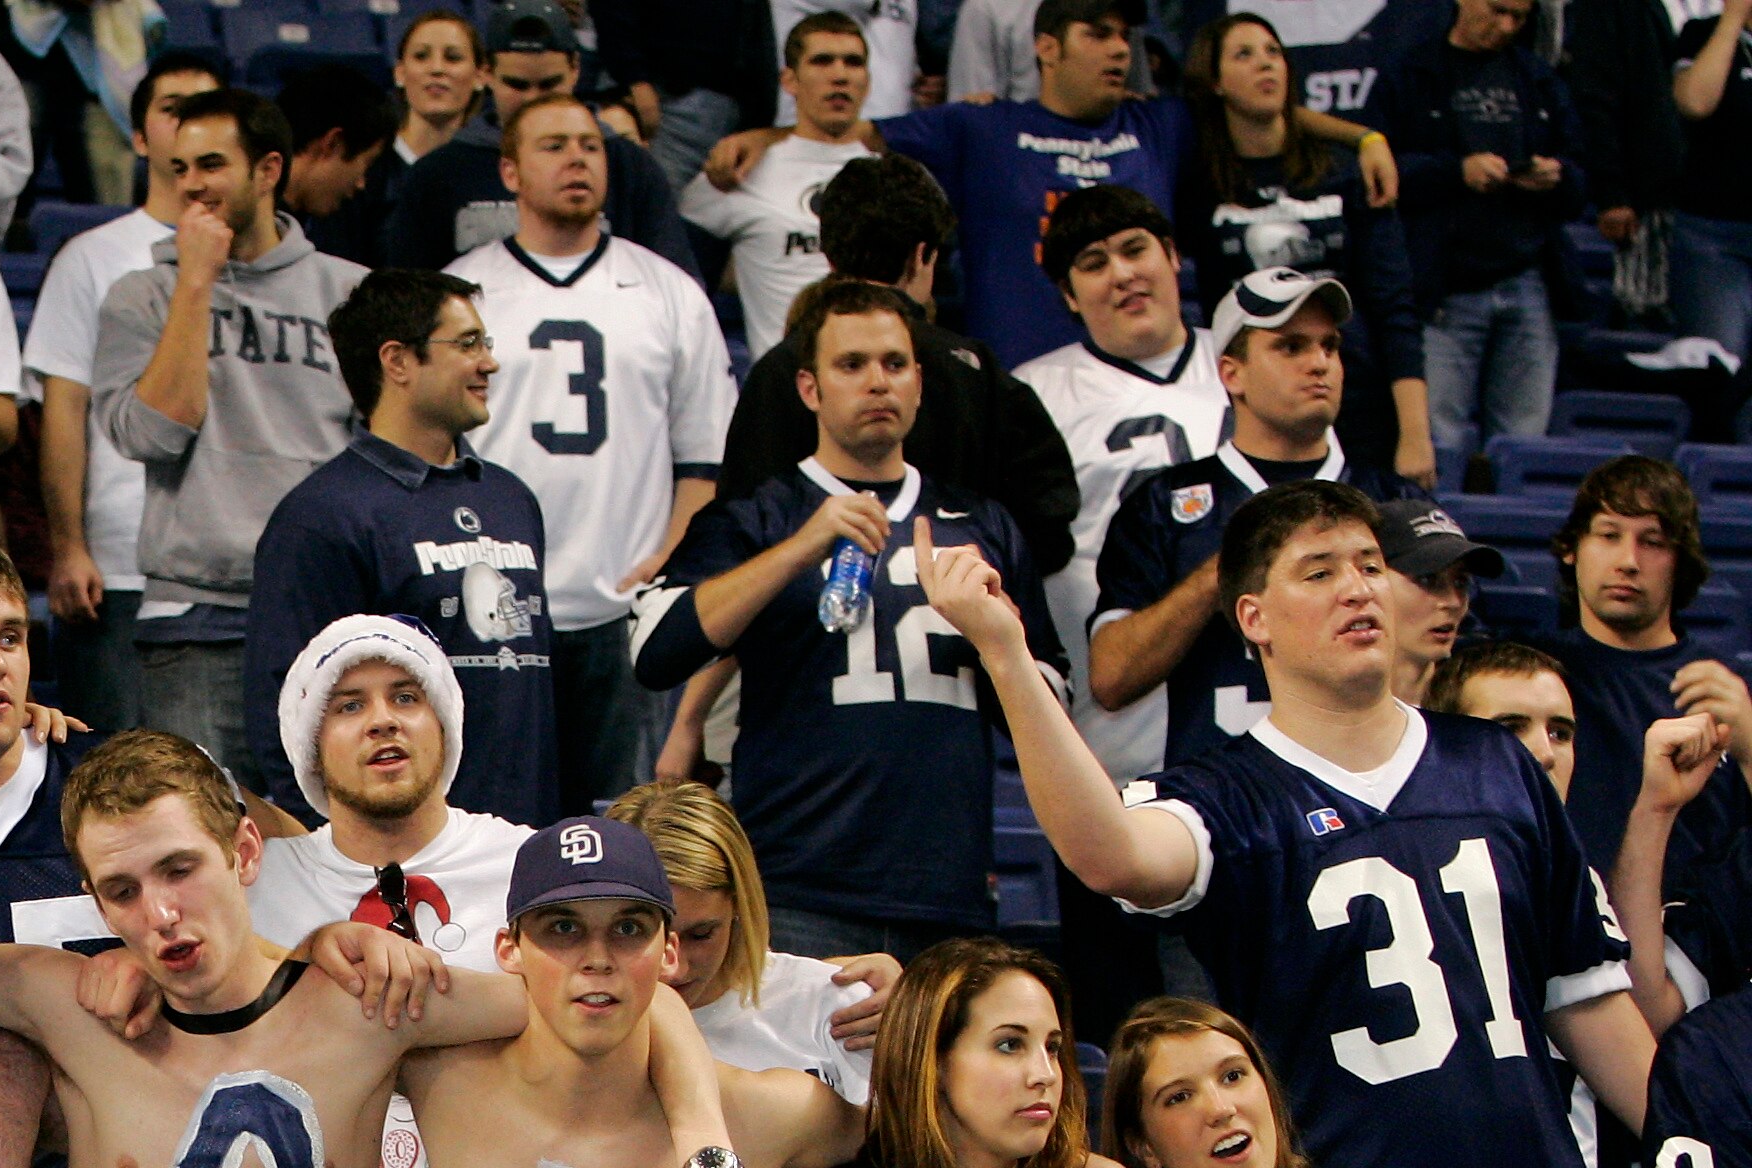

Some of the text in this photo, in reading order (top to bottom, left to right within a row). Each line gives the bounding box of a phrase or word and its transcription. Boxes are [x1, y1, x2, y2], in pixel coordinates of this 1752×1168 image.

[209, 303, 332, 374] TATE
[528, 319, 609, 456] 3
[559, 823, 604, 866] SD
[1307, 838, 1528, 1086] 31
